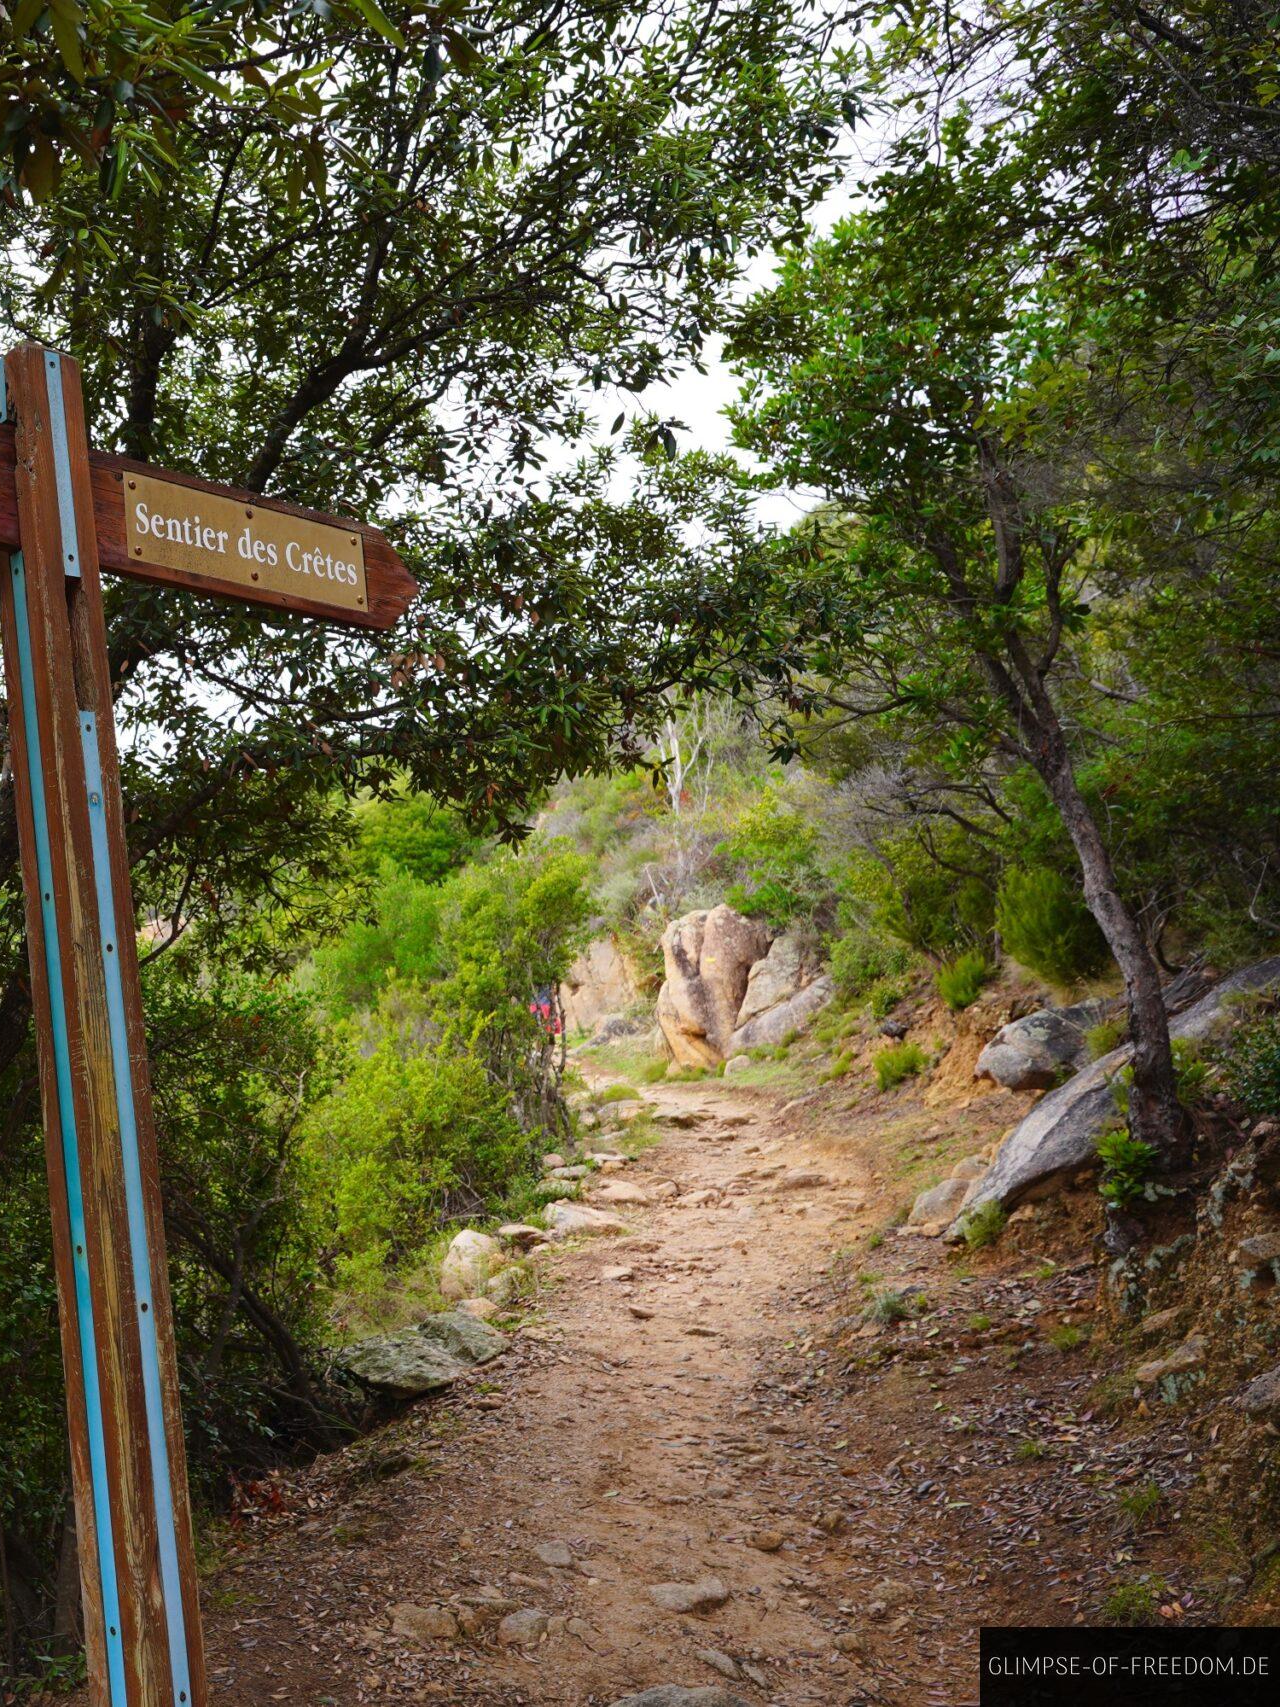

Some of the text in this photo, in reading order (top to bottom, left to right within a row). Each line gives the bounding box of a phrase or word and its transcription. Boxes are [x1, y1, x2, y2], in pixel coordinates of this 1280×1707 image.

[135, 502, 358, 586] Sentier des Crêtes
